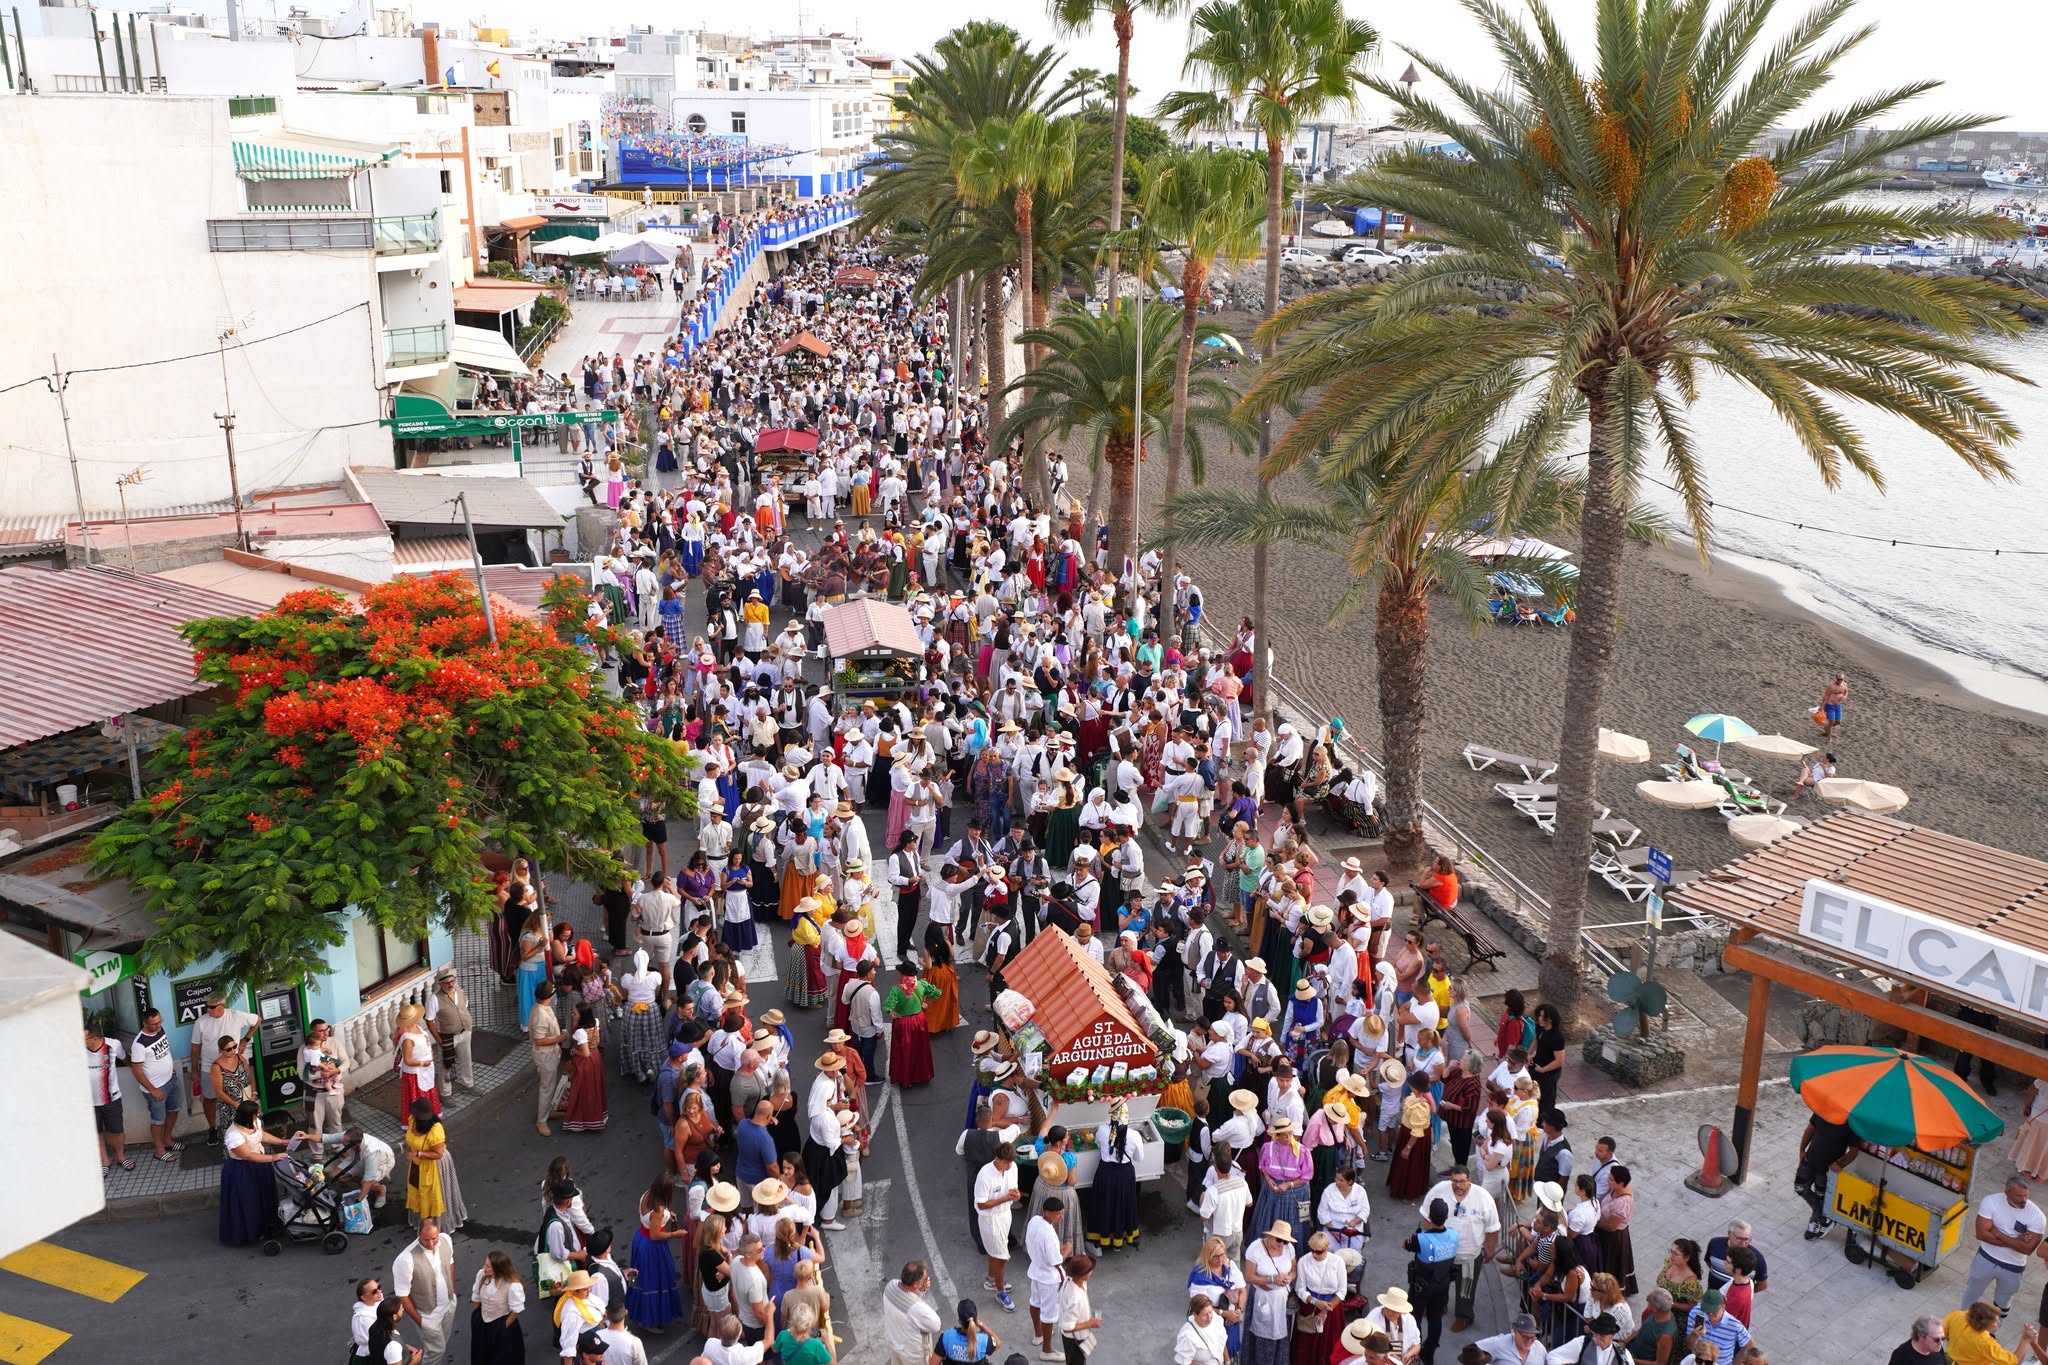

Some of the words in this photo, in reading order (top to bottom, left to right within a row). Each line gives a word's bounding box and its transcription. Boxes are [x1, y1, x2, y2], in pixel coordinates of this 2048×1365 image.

[495, 416, 542, 427] Ocean
[545, 414, 564, 425] Blu
[1809, 890, 1889, 960] EL
[90, 957, 120, 979] ATM
[186, 986, 212, 997] Cajero
[1094, 1021, 1114, 1034] ST
[1072, 1032, 1133, 1050] AGUEDA
[1051, 1043, 1148, 1065] ARGUINEGUIN
[271, 1065, 298, 1082] ATM
